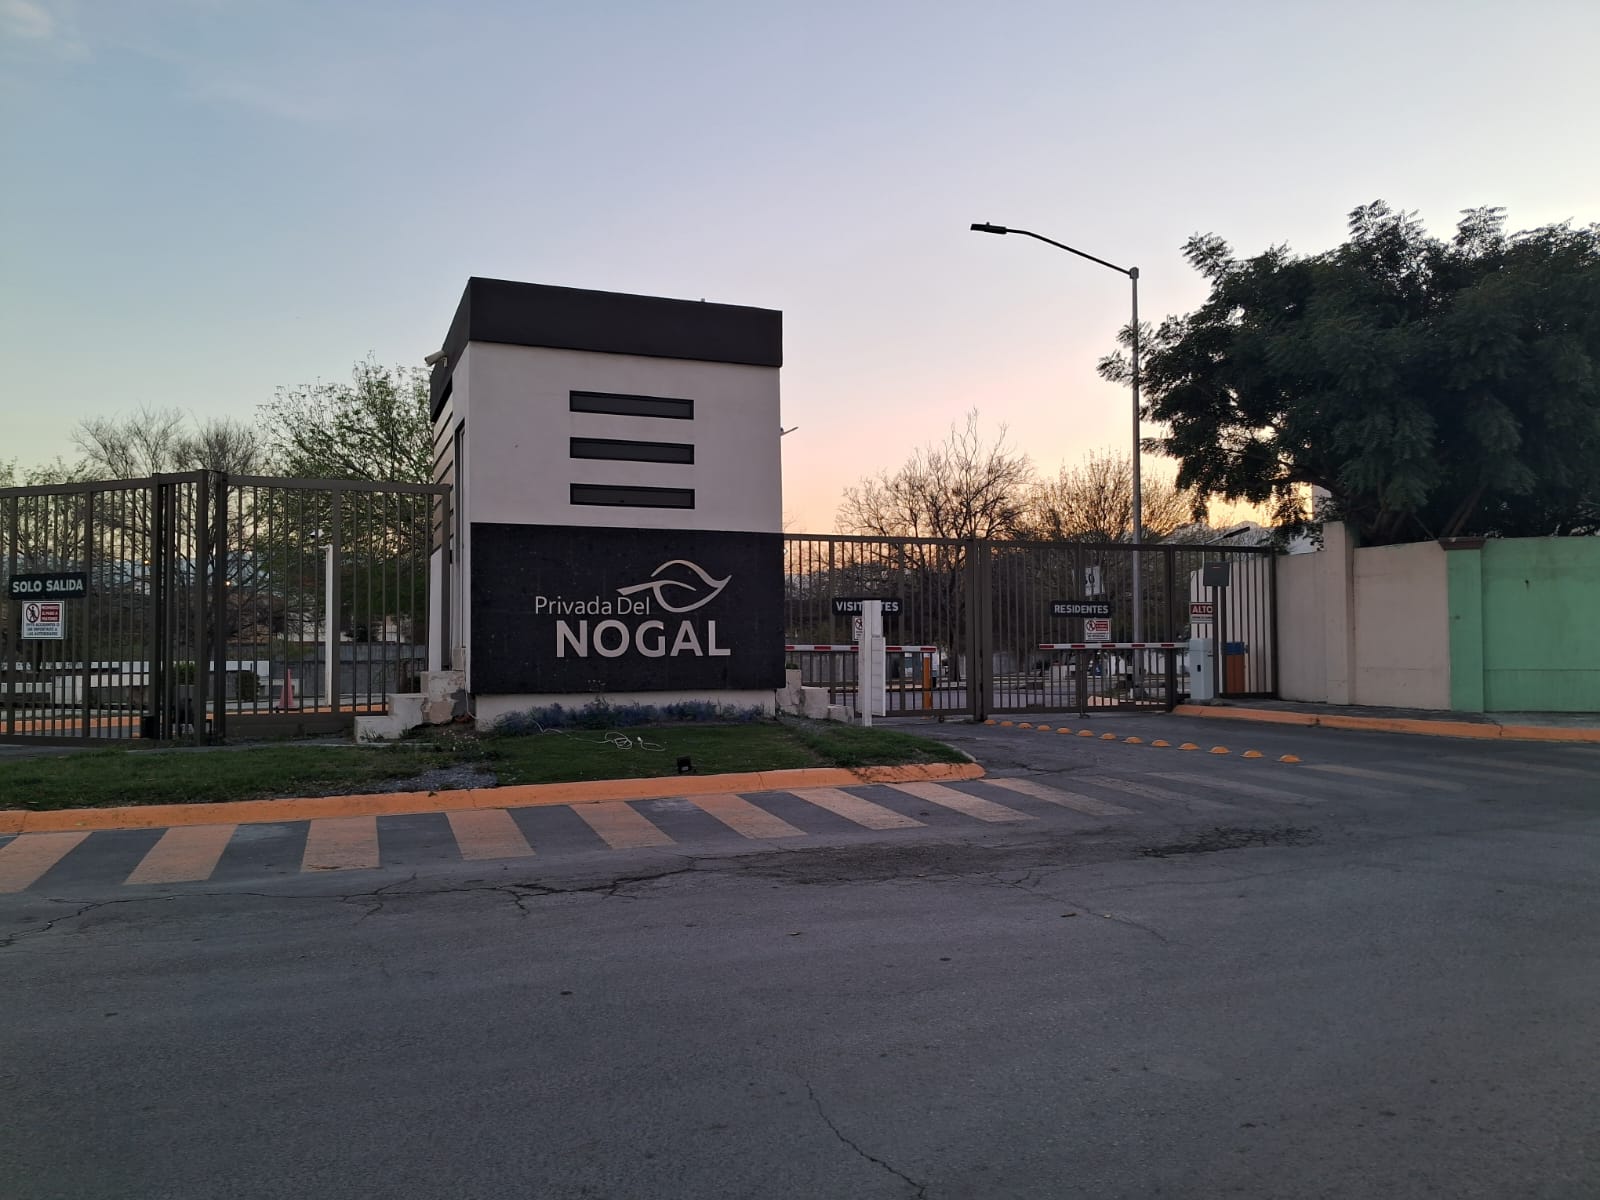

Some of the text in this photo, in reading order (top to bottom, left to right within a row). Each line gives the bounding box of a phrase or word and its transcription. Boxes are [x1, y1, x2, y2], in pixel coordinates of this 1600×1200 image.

[12, 578, 84, 593] SOLO SALIDA
[535, 596, 650, 615] Privada Del
[835, 601, 899, 612] VISITTES
[1054, 604, 1109, 614] RESIDENTES
[1191, 605, 1213, 614] ALTO
[556, 619, 731, 658] NOGAL
